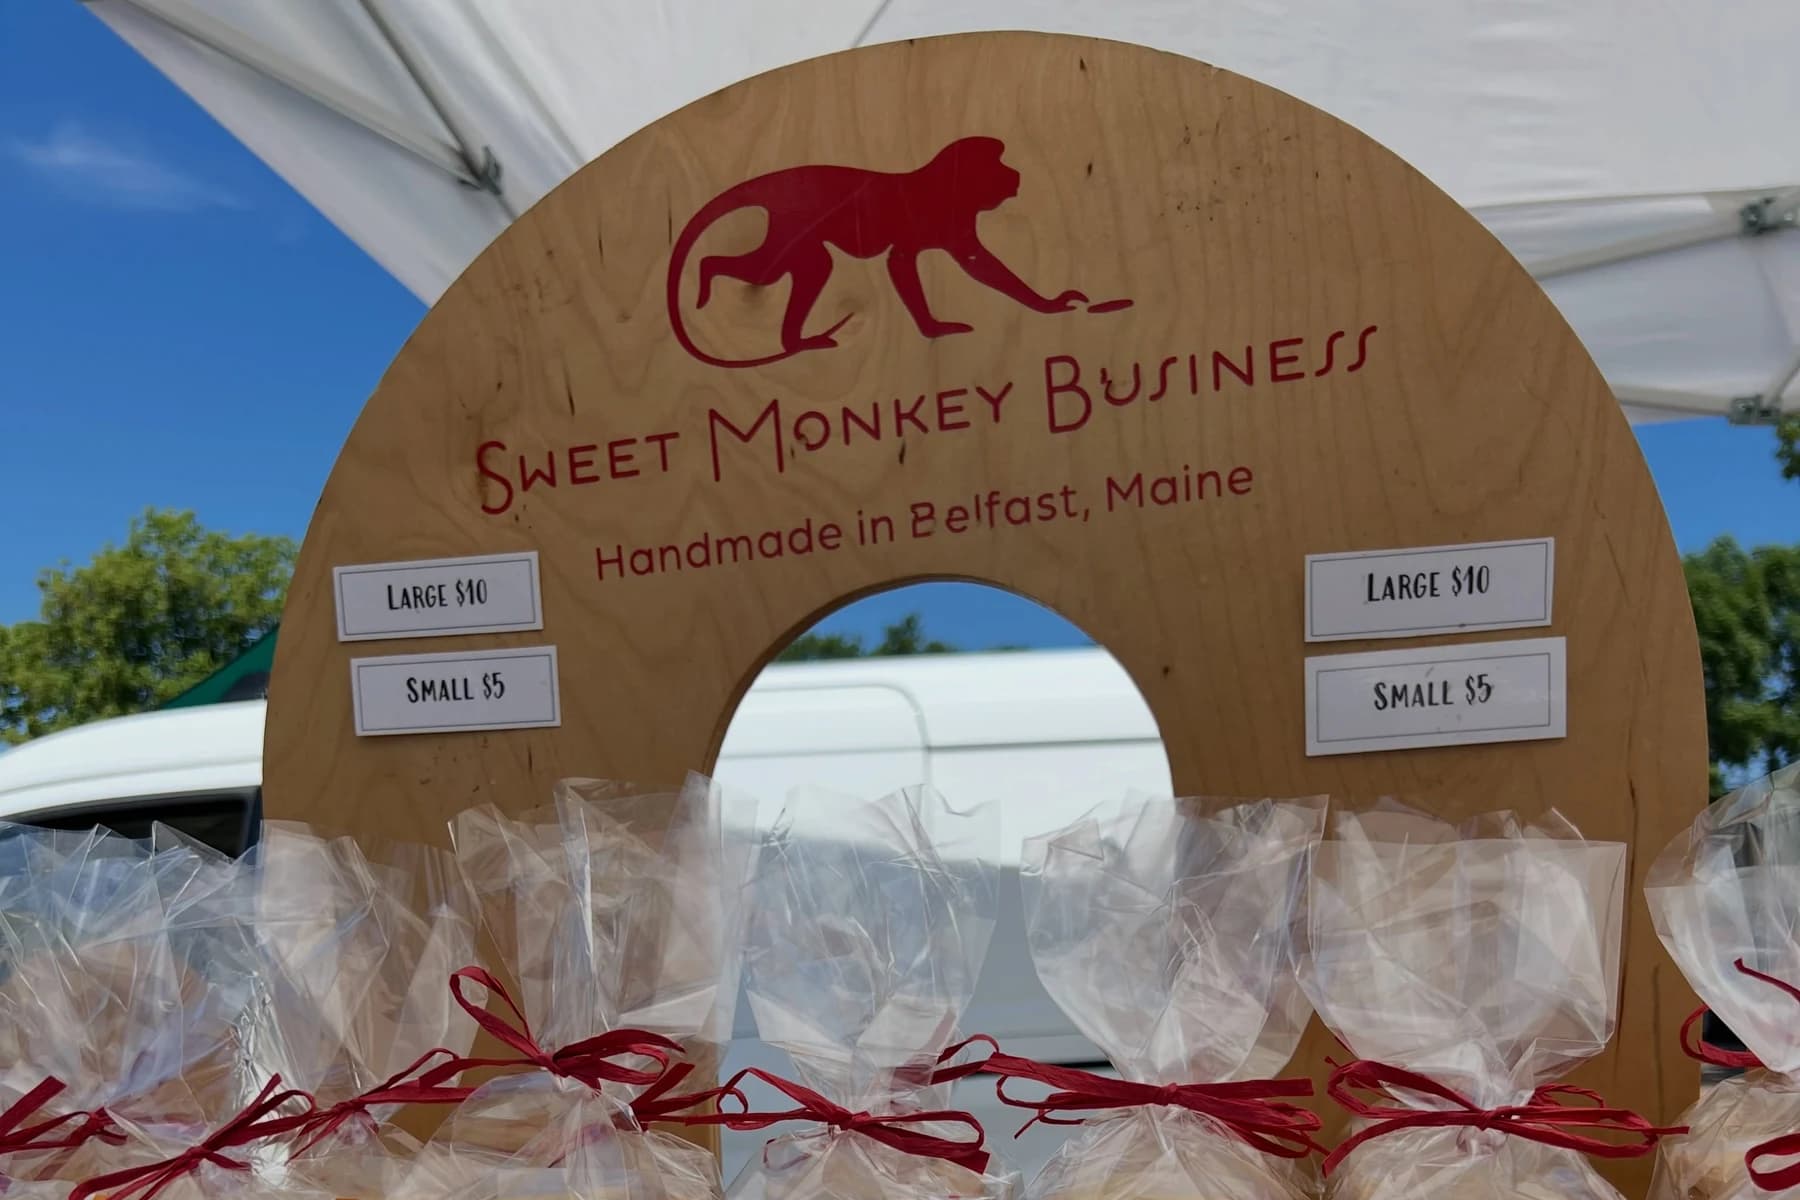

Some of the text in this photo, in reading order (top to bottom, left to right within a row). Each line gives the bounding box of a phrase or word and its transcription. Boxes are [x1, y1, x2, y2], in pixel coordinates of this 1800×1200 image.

[476, 325, 1378, 515] SWEET MONKEY BUSINESS
[595, 464, 1253, 580] Handmade in Belfast, Maine
[387, 578, 488, 610] LARGE $10
[1367, 565, 1489, 602] LARGE $10
[406, 672, 505, 703] SMALL $5
[1374, 674, 1492, 710] SMALL $5
